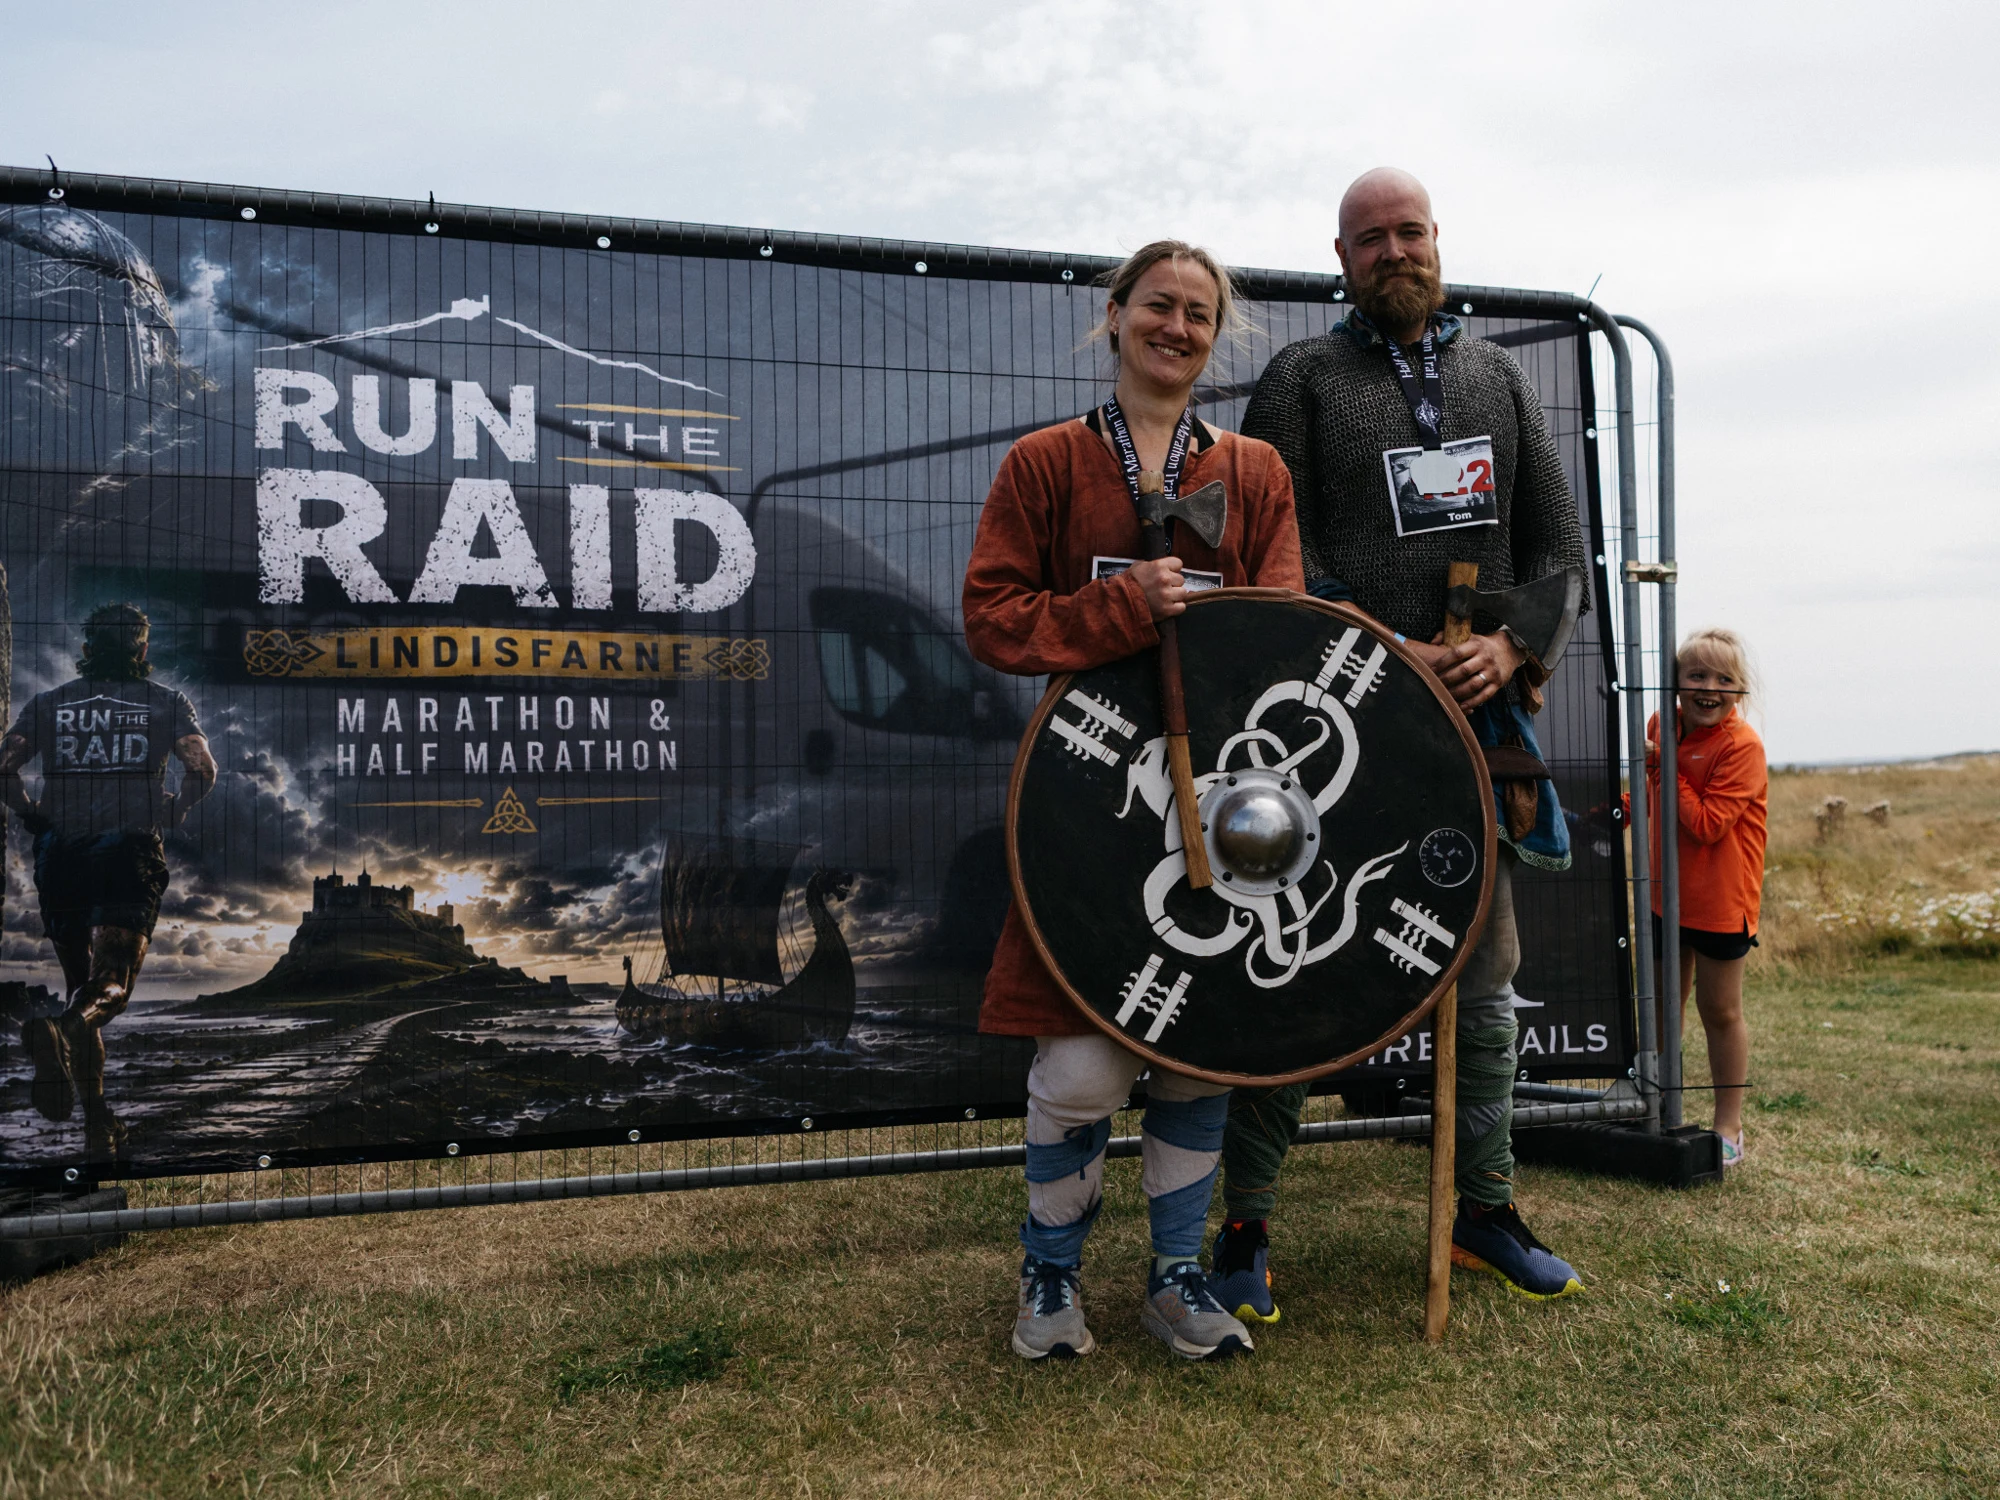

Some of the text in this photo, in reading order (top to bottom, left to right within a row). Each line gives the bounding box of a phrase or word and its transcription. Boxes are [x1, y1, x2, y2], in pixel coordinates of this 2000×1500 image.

[1424, 353, 1439, 379] Trail
[254, 367, 536, 463] RUN
[571, 420, 721, 457] THE
[1113, 419, 1140, 473] Marathon
[1168, 421, 1190, 469] Marathon
[1447, 511, 1472, 521] Tom
[255, 466, 758, 613] RAID
[335, 634, 696, 674] LINDISFARNE
[56, 709, 110, 732] RUN
[117, 714, 148, 725] THE
[337, 696, 671, 733] MARATHON &
[55, 735, 149, 766] RAID
[336, 738, 677, 777] HALF MARATHON
[1355, 1023, 1608, 1066] RE AILS
